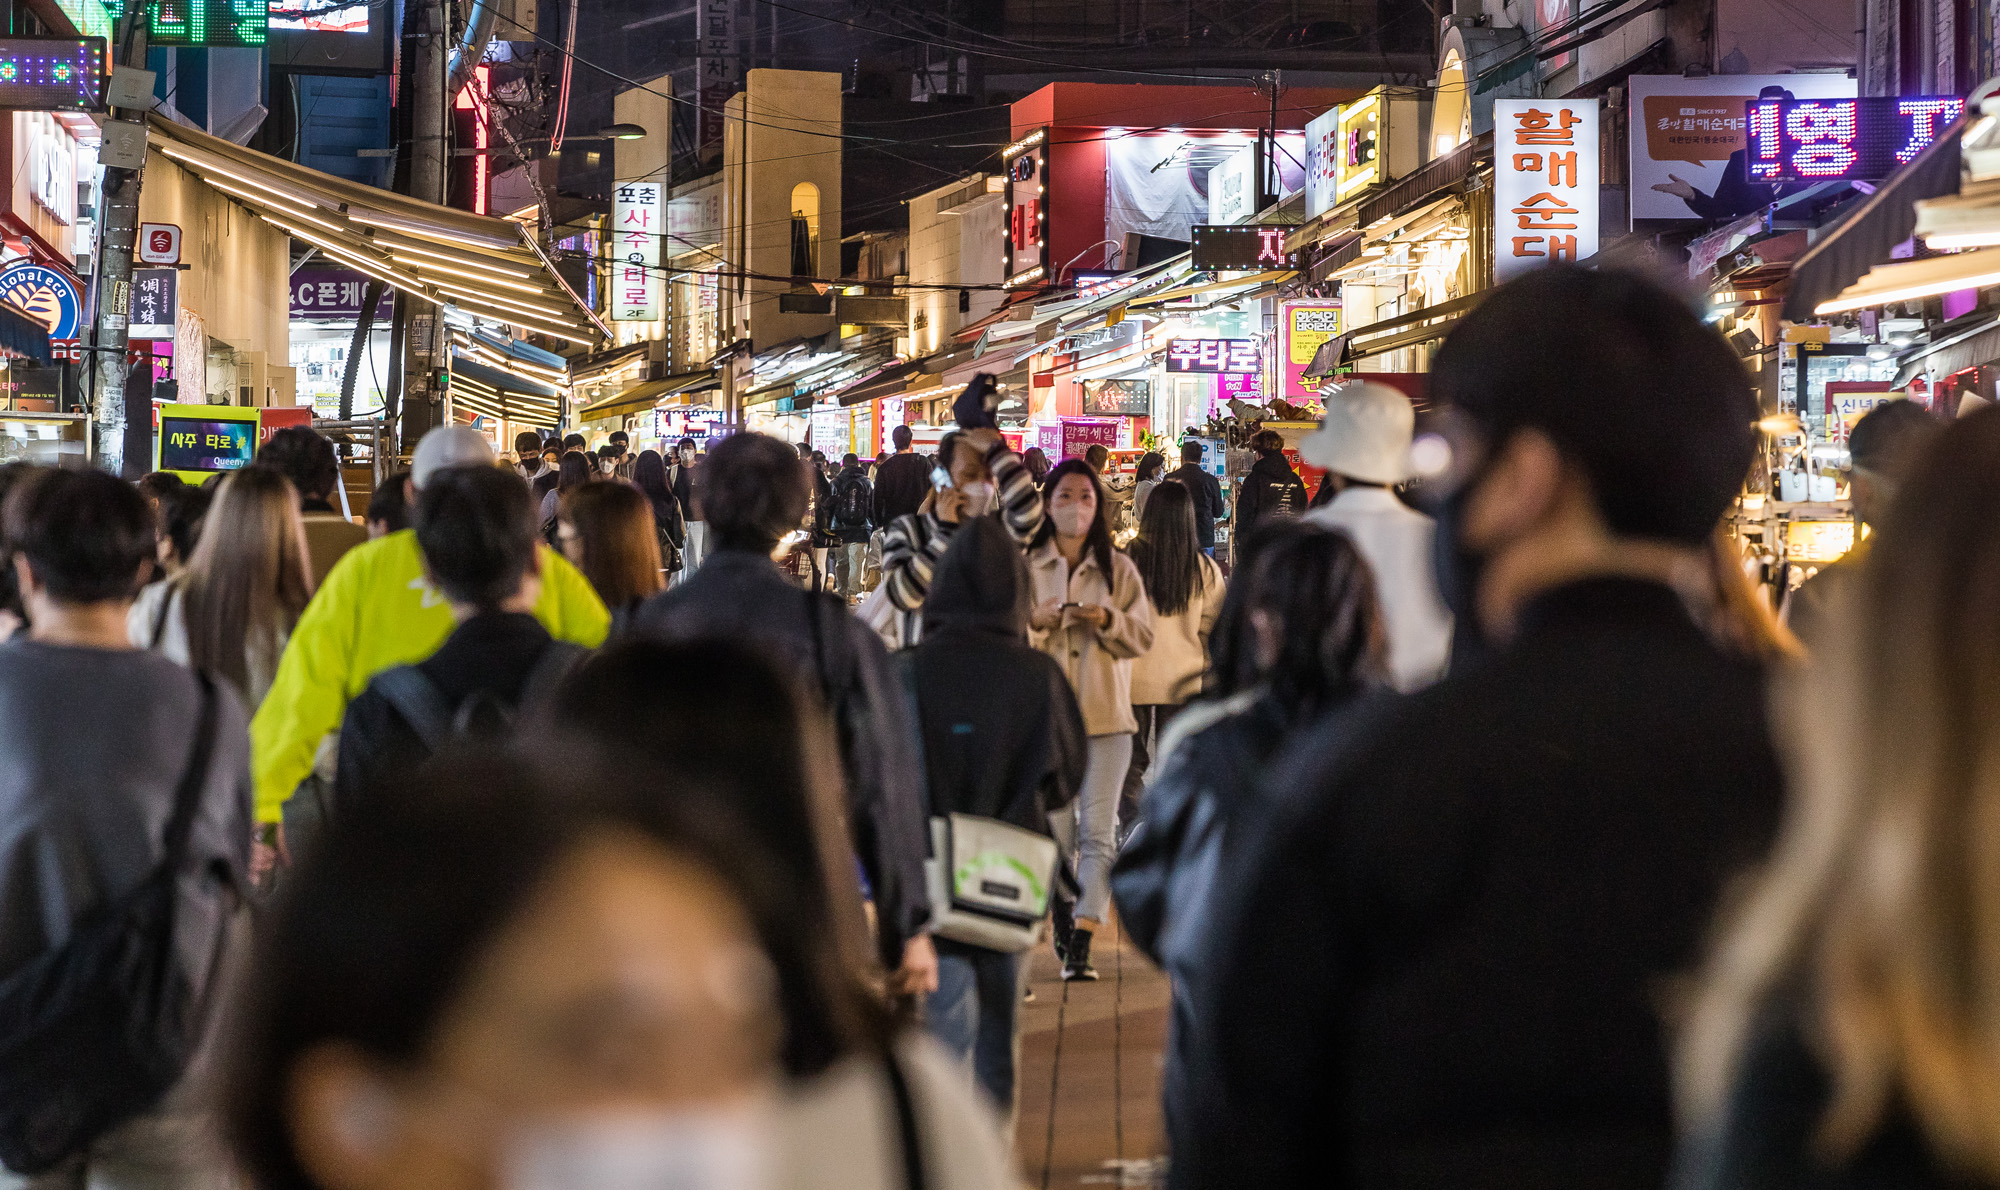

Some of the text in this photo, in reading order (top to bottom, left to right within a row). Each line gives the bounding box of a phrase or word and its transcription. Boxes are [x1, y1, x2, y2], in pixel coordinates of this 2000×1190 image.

[1511, 108, 1582, 262] 할매순대
[619, 187, 655, 205] 포춘
[0, 271, 67, 298] global eco
[171, 432, 197, 449] 사주
[206, 434, 231, 450] 타로
[213, 456, 245, 468] Queeny
